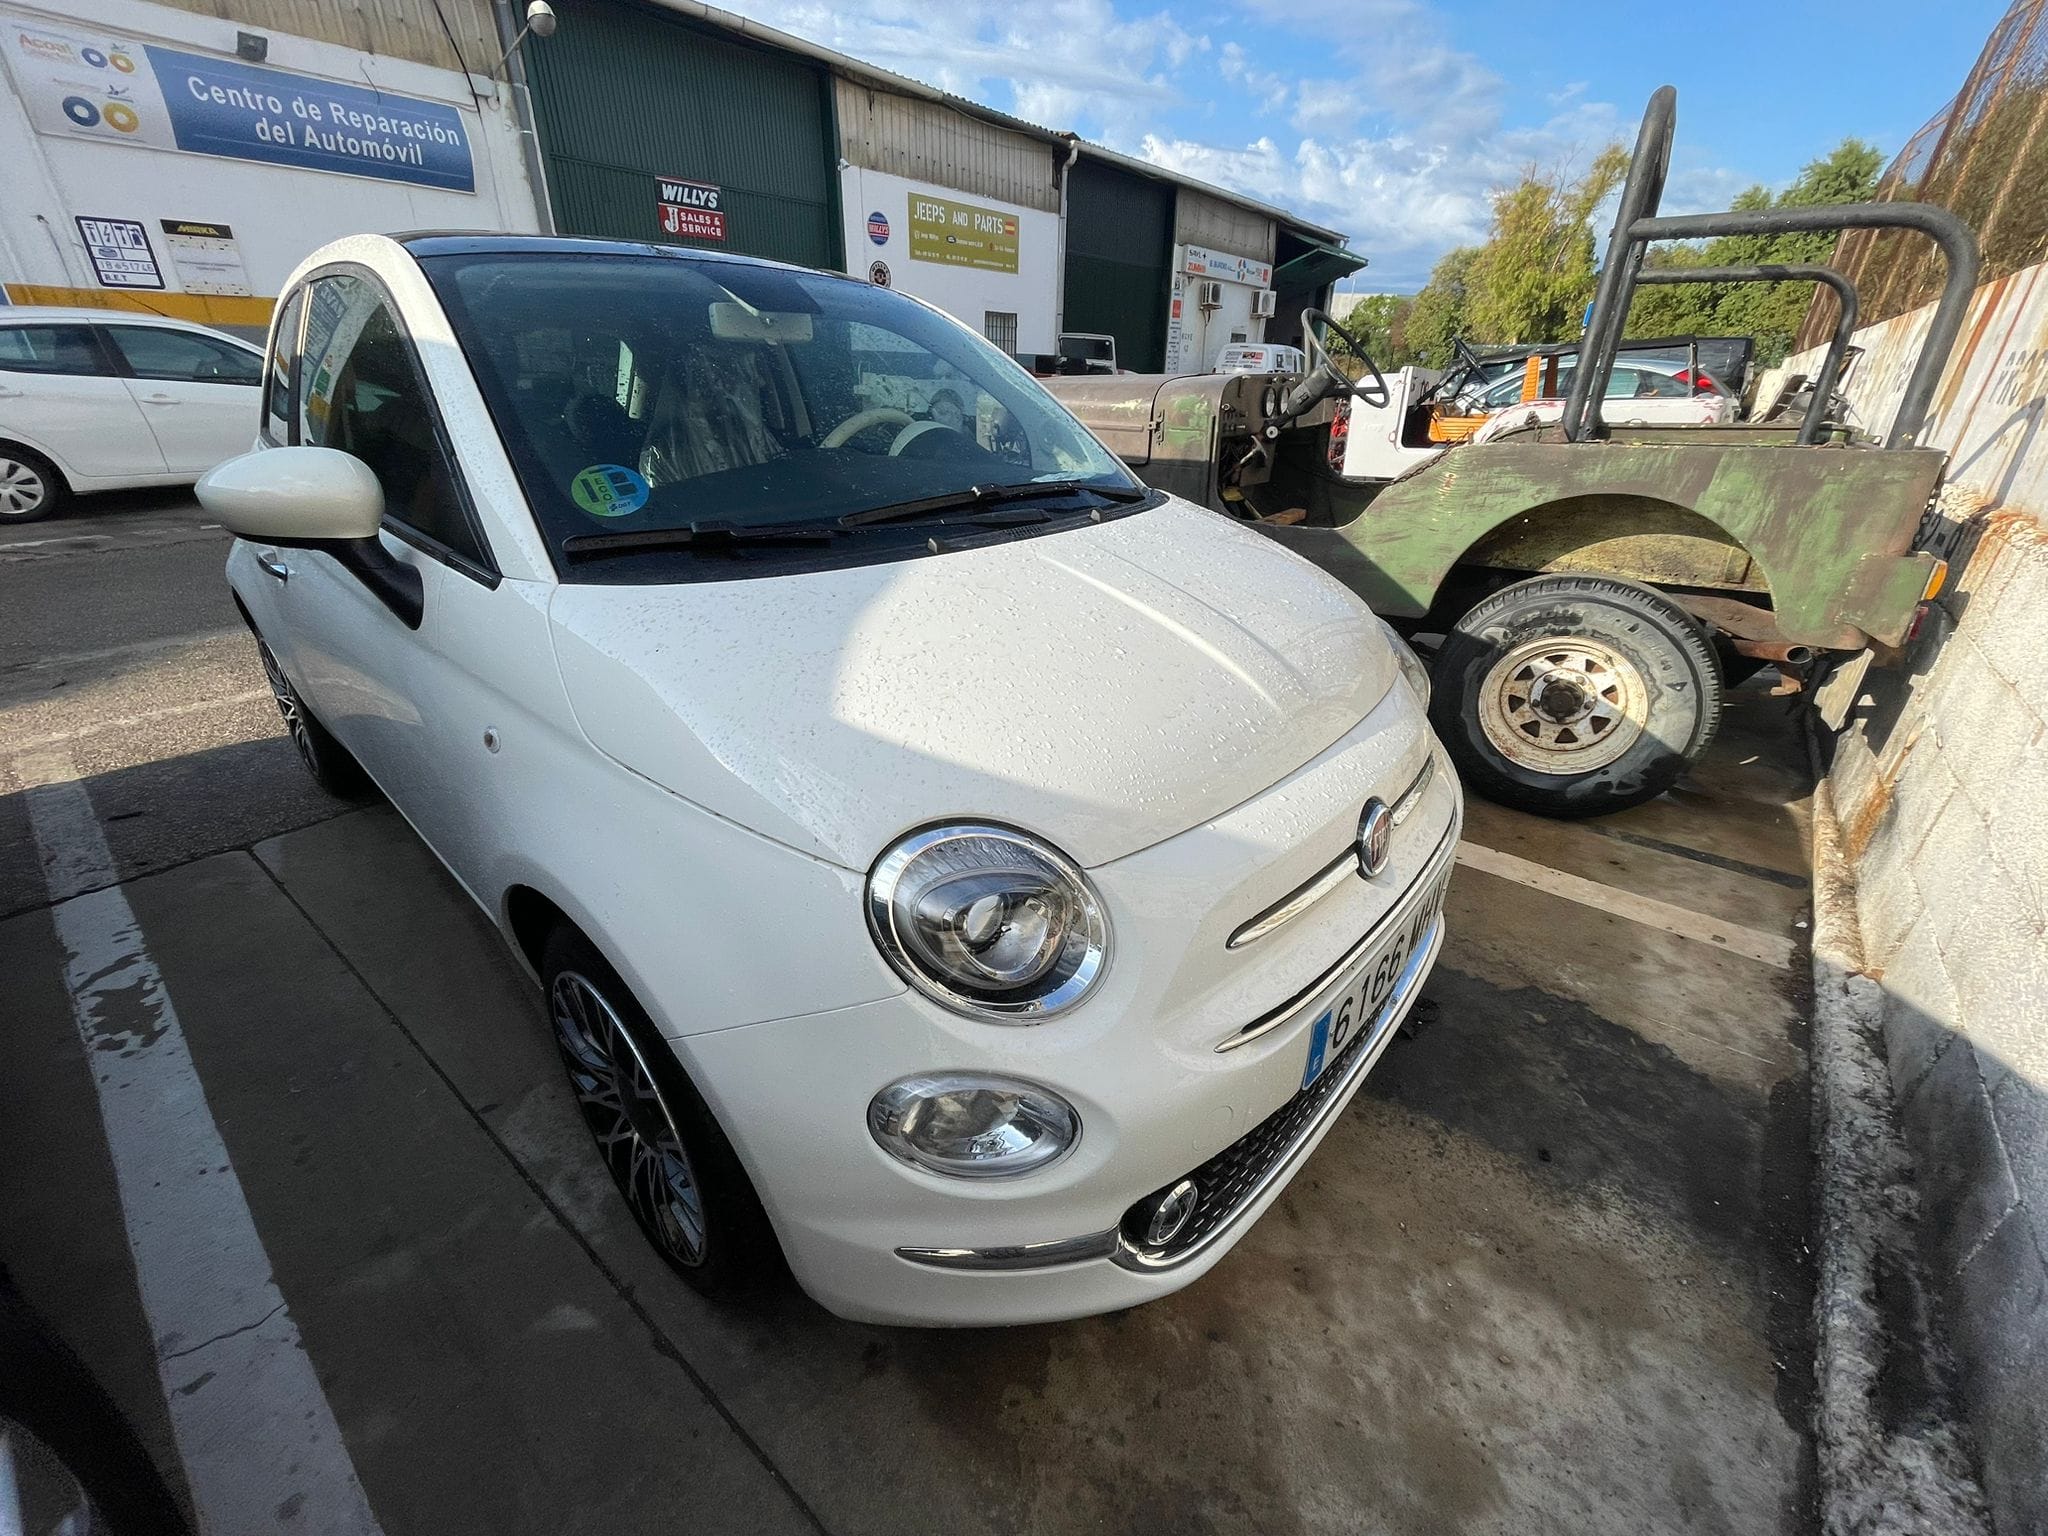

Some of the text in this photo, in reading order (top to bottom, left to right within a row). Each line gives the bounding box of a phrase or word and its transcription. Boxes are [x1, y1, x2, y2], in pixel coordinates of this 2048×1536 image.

[187, 75, 460, 146] Centro de Reparación
[255, 117, 423, 165] del Automóvil
[662, 184, 718, 208] WILLYS
[681, 212, 711, 224] SALES
[682, 223, 721, 236] SERVICE
[914, 201, 1003, 234] JEEPS AND PARTS
[592, 478, 613, 501] ECO
[1332, 933, 1405, 1049] 6166
